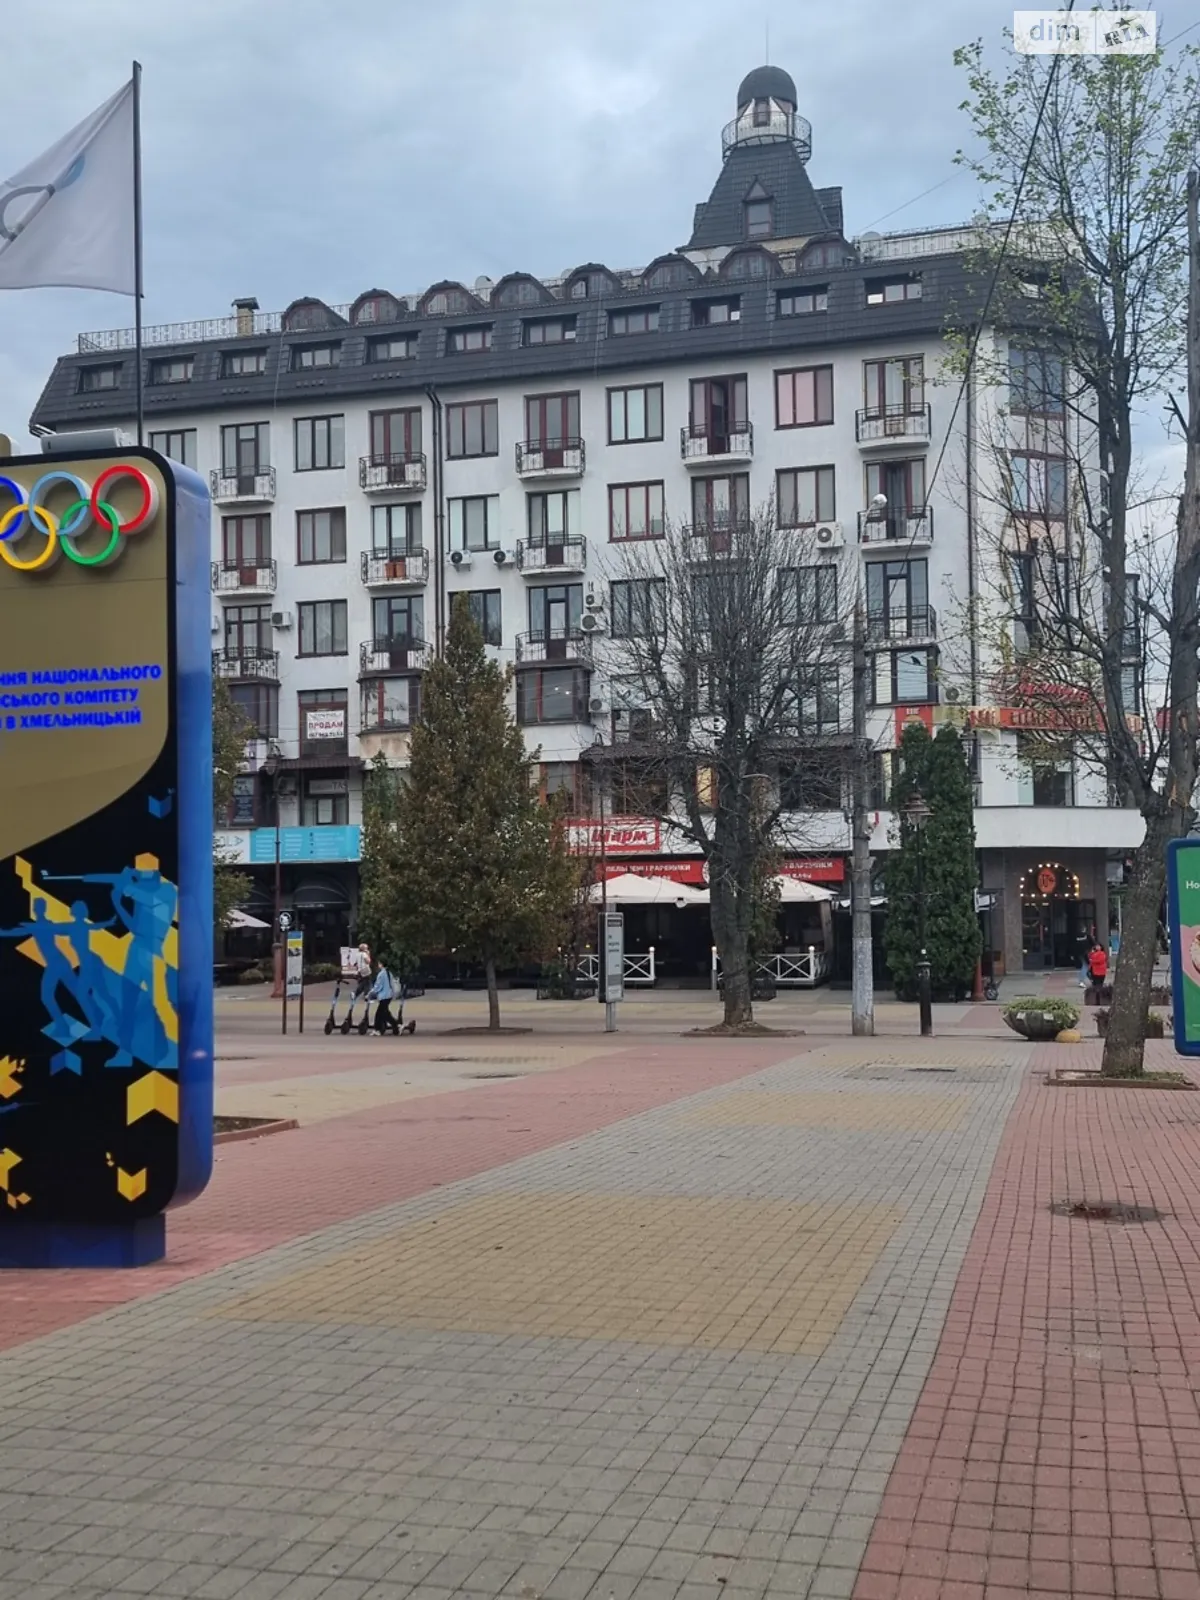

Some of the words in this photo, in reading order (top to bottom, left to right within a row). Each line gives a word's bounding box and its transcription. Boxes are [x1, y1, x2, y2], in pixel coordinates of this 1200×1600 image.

[32, 665, 161, 683] НАЦІОНАЛЬНОГО
[0, 692, 60, 707] СЬКОГО
[65, 688, 139, 704] КОМІТЕТУ
[5, 715, 16, 730] В
[21, 707, 141, 728] ХМЕЛЬНИЦЬКІЙ
[308, 721, 343, 729] ПРОДАМ
[1185, 880, 1200, 889] Но
